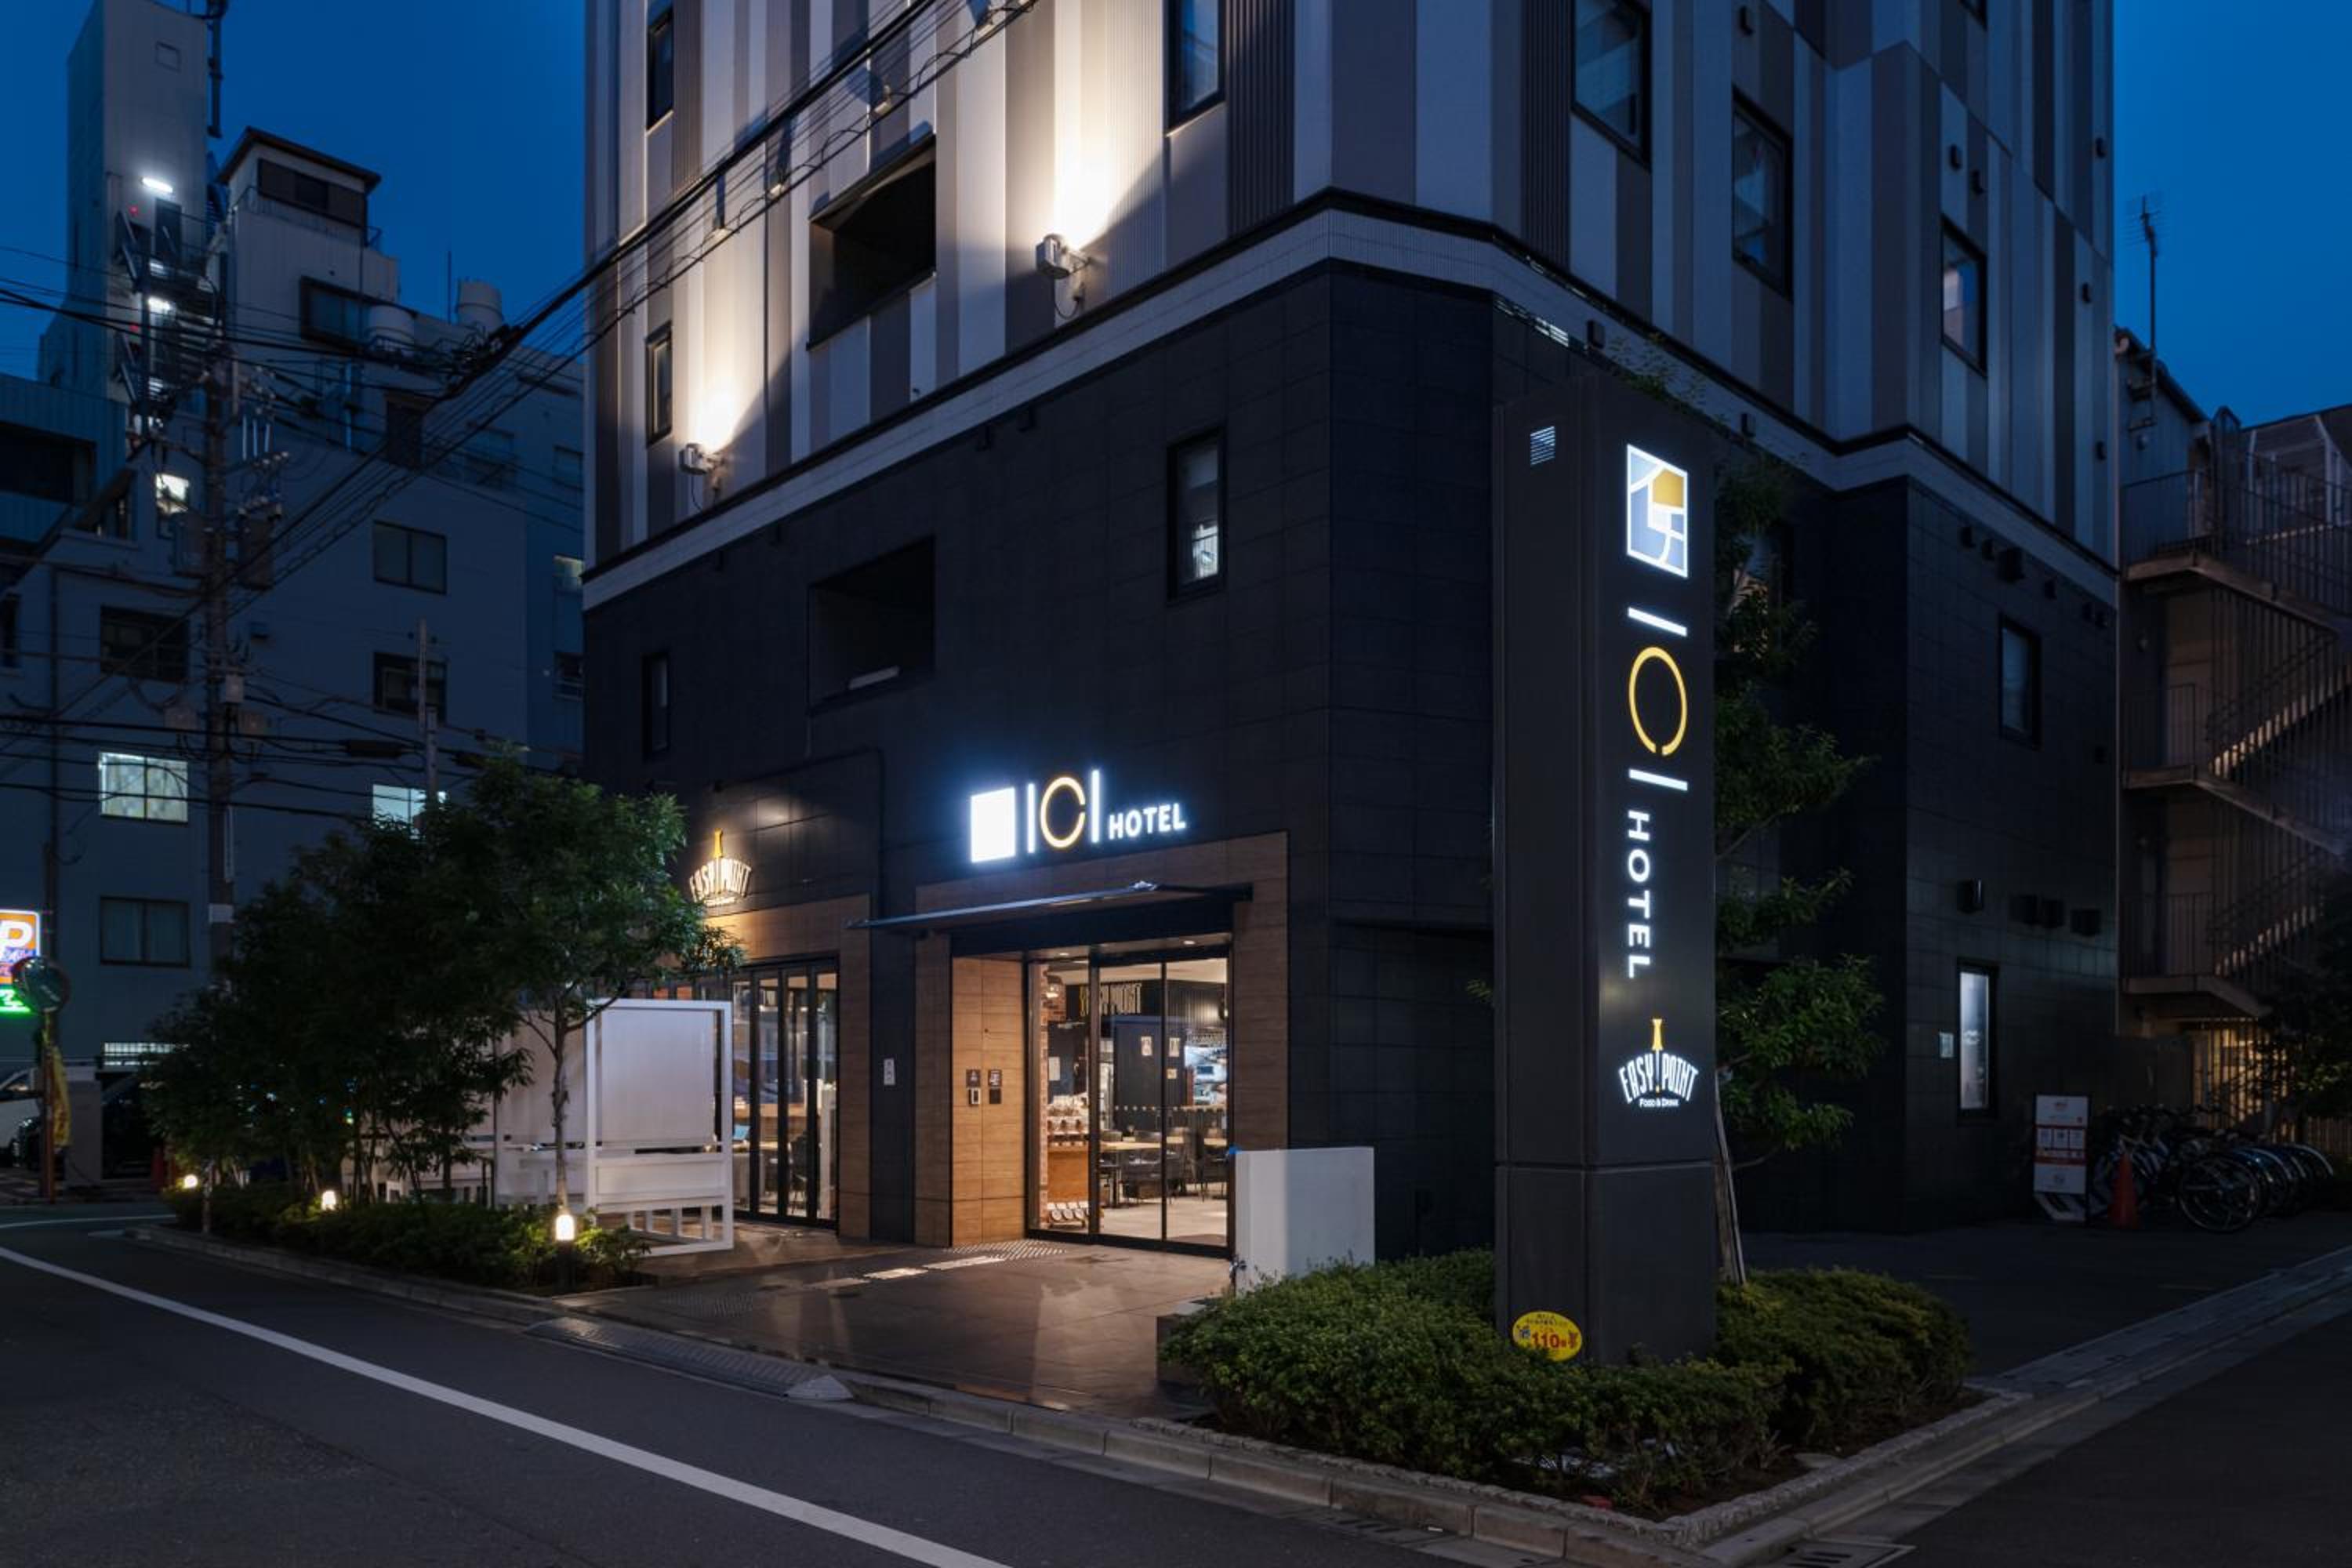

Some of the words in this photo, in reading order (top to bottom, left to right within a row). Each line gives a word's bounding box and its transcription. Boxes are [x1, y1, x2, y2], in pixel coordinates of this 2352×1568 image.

[1108, 802, 1186, 840] HOTEL
[1628, 810, 1651, 978] HOTEL
[1618, 1053, 1653, 1104] EASY
[1661, 1053, 1699, 1102] POINT
